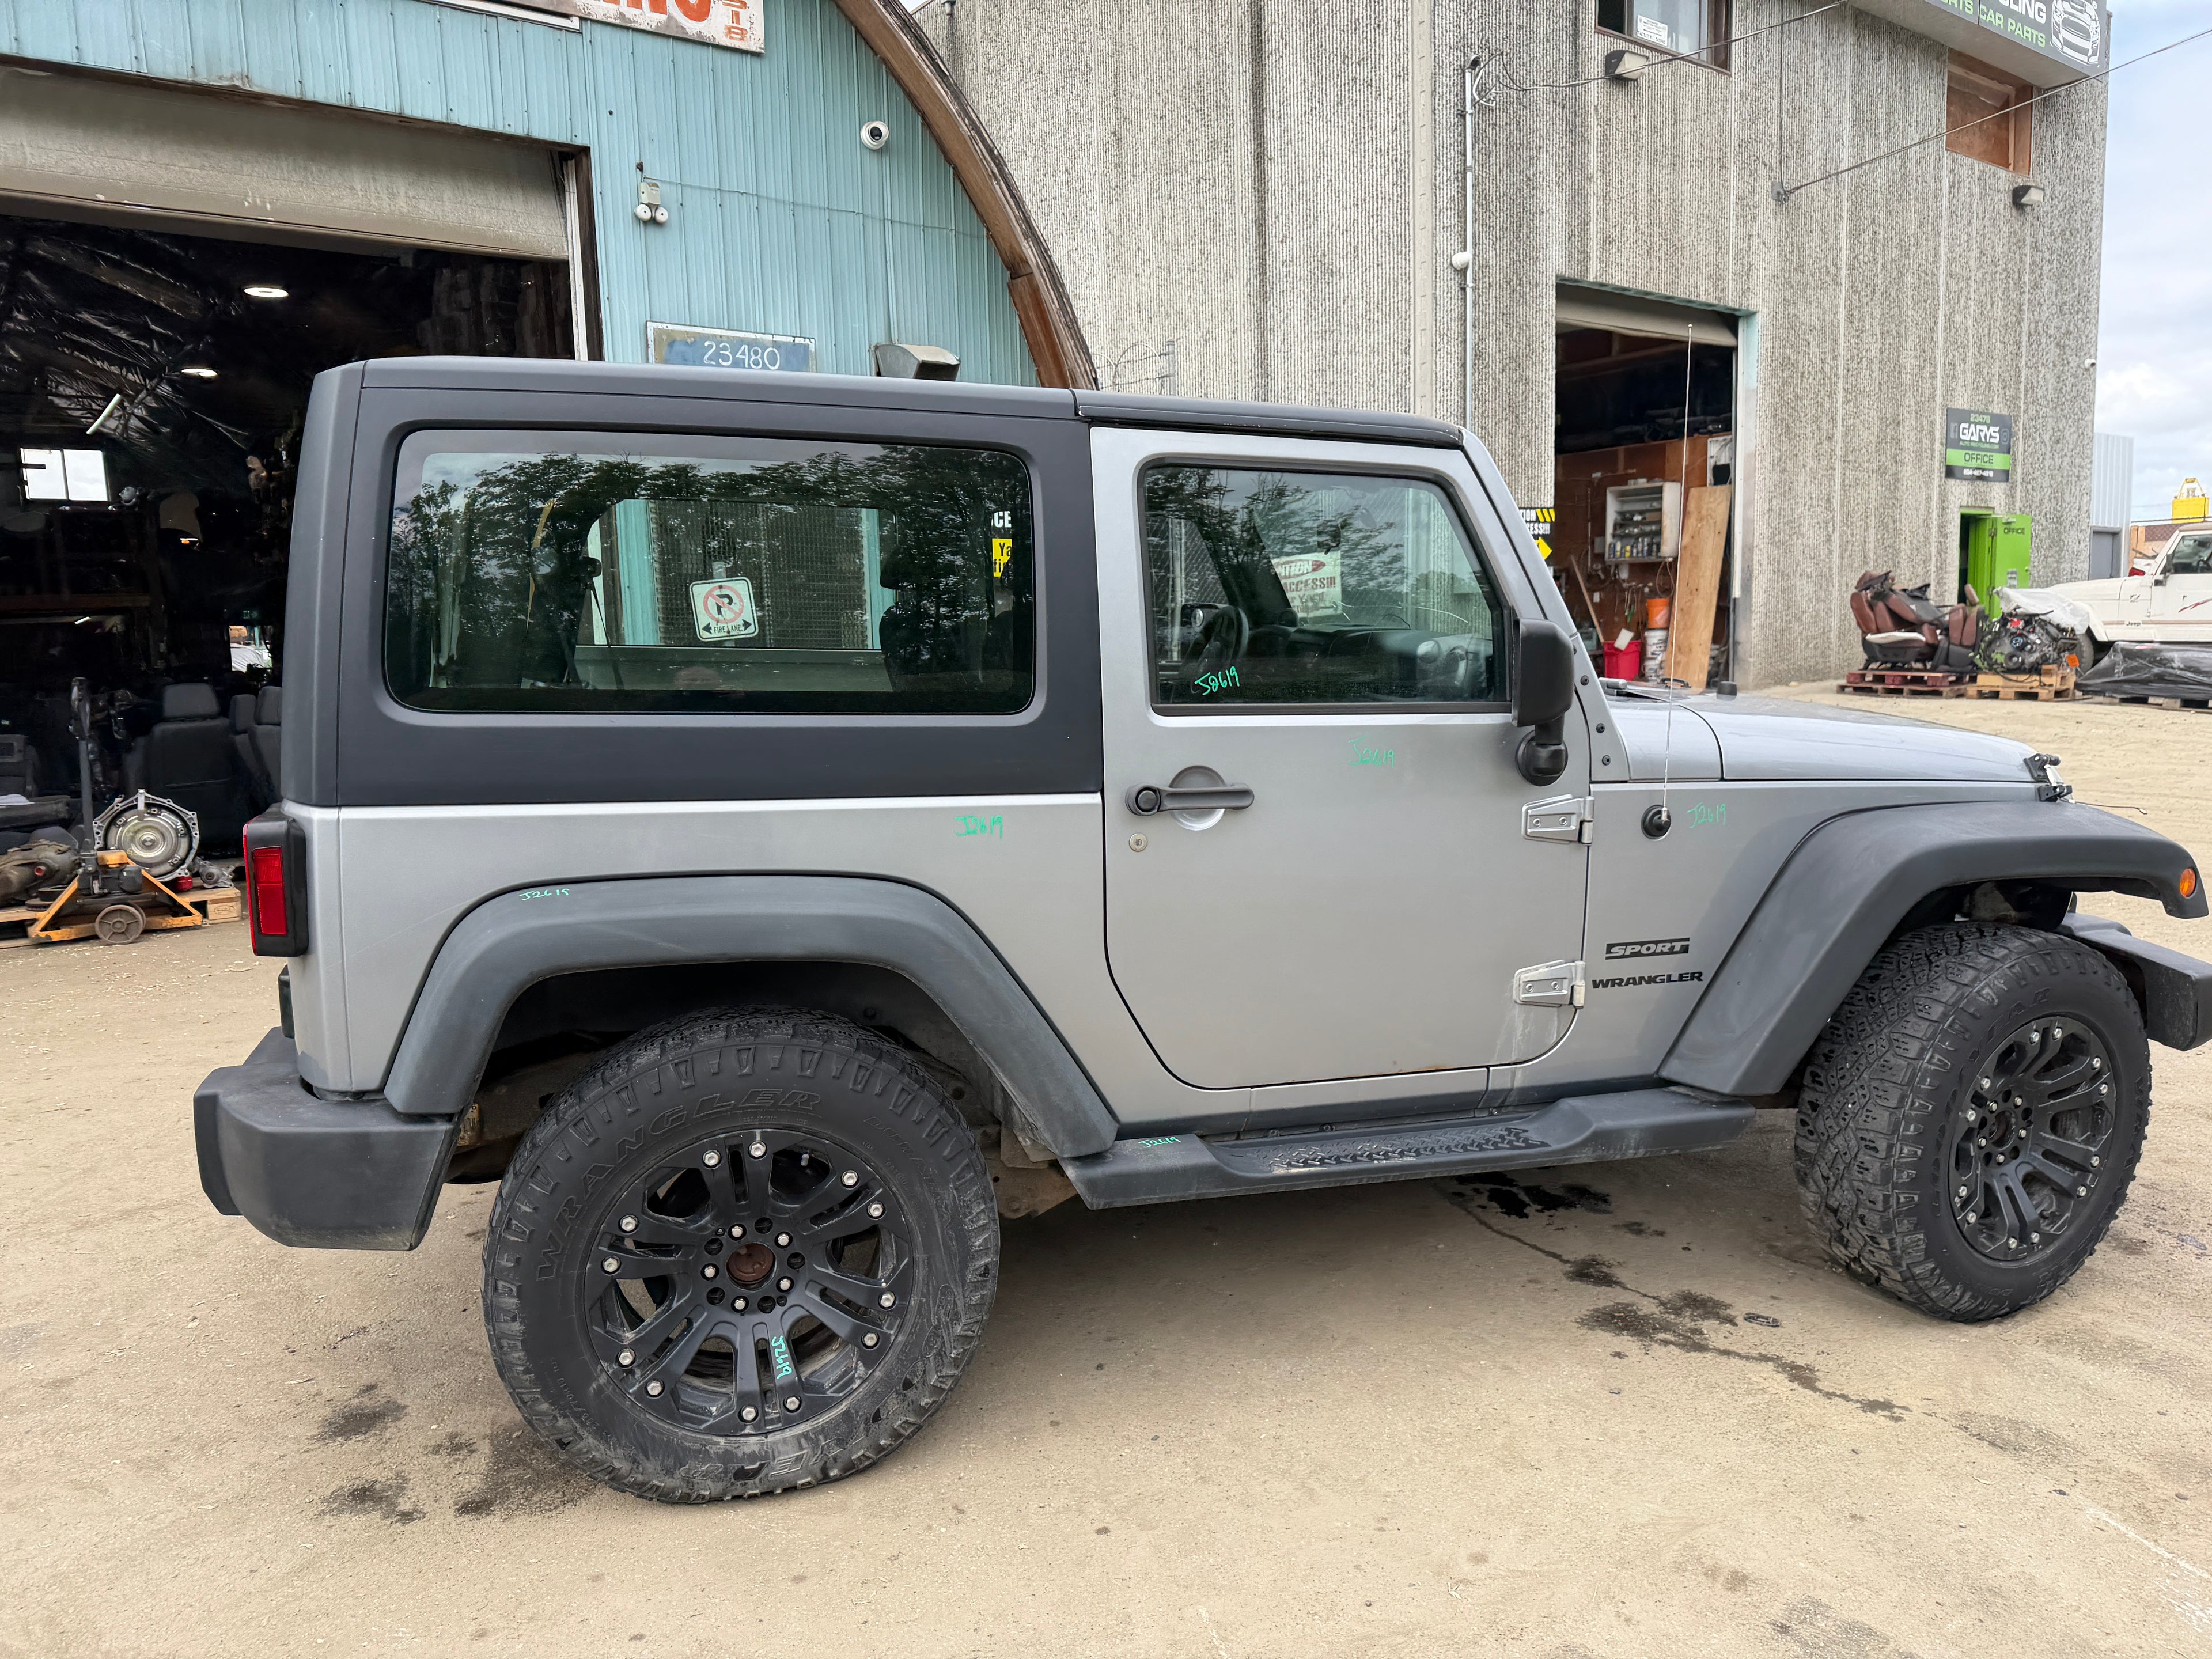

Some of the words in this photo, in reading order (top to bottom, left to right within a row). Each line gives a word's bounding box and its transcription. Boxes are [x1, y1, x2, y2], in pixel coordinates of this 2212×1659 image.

[1999, 0, 2046, 24] LING
[1979, 4, 2003, 29] CAR
[2008, 18, 2046, 47] PARTS
[703, 341, 780, 370] 23480
[1959, 422, 1999, 443] GARYS
[1964, 452, 1994, 464] OFFICE
[991, 511, 1012, 528] CE
[714, 626, 726, 634] FIRE
[1610, 942, 1690, 956] SPORT
[1592, 971, 1703, 988] WRANGLER
[537, 1089, 821, 1281] WRANGLER
[771, 1335, 793, 1380] J2619
